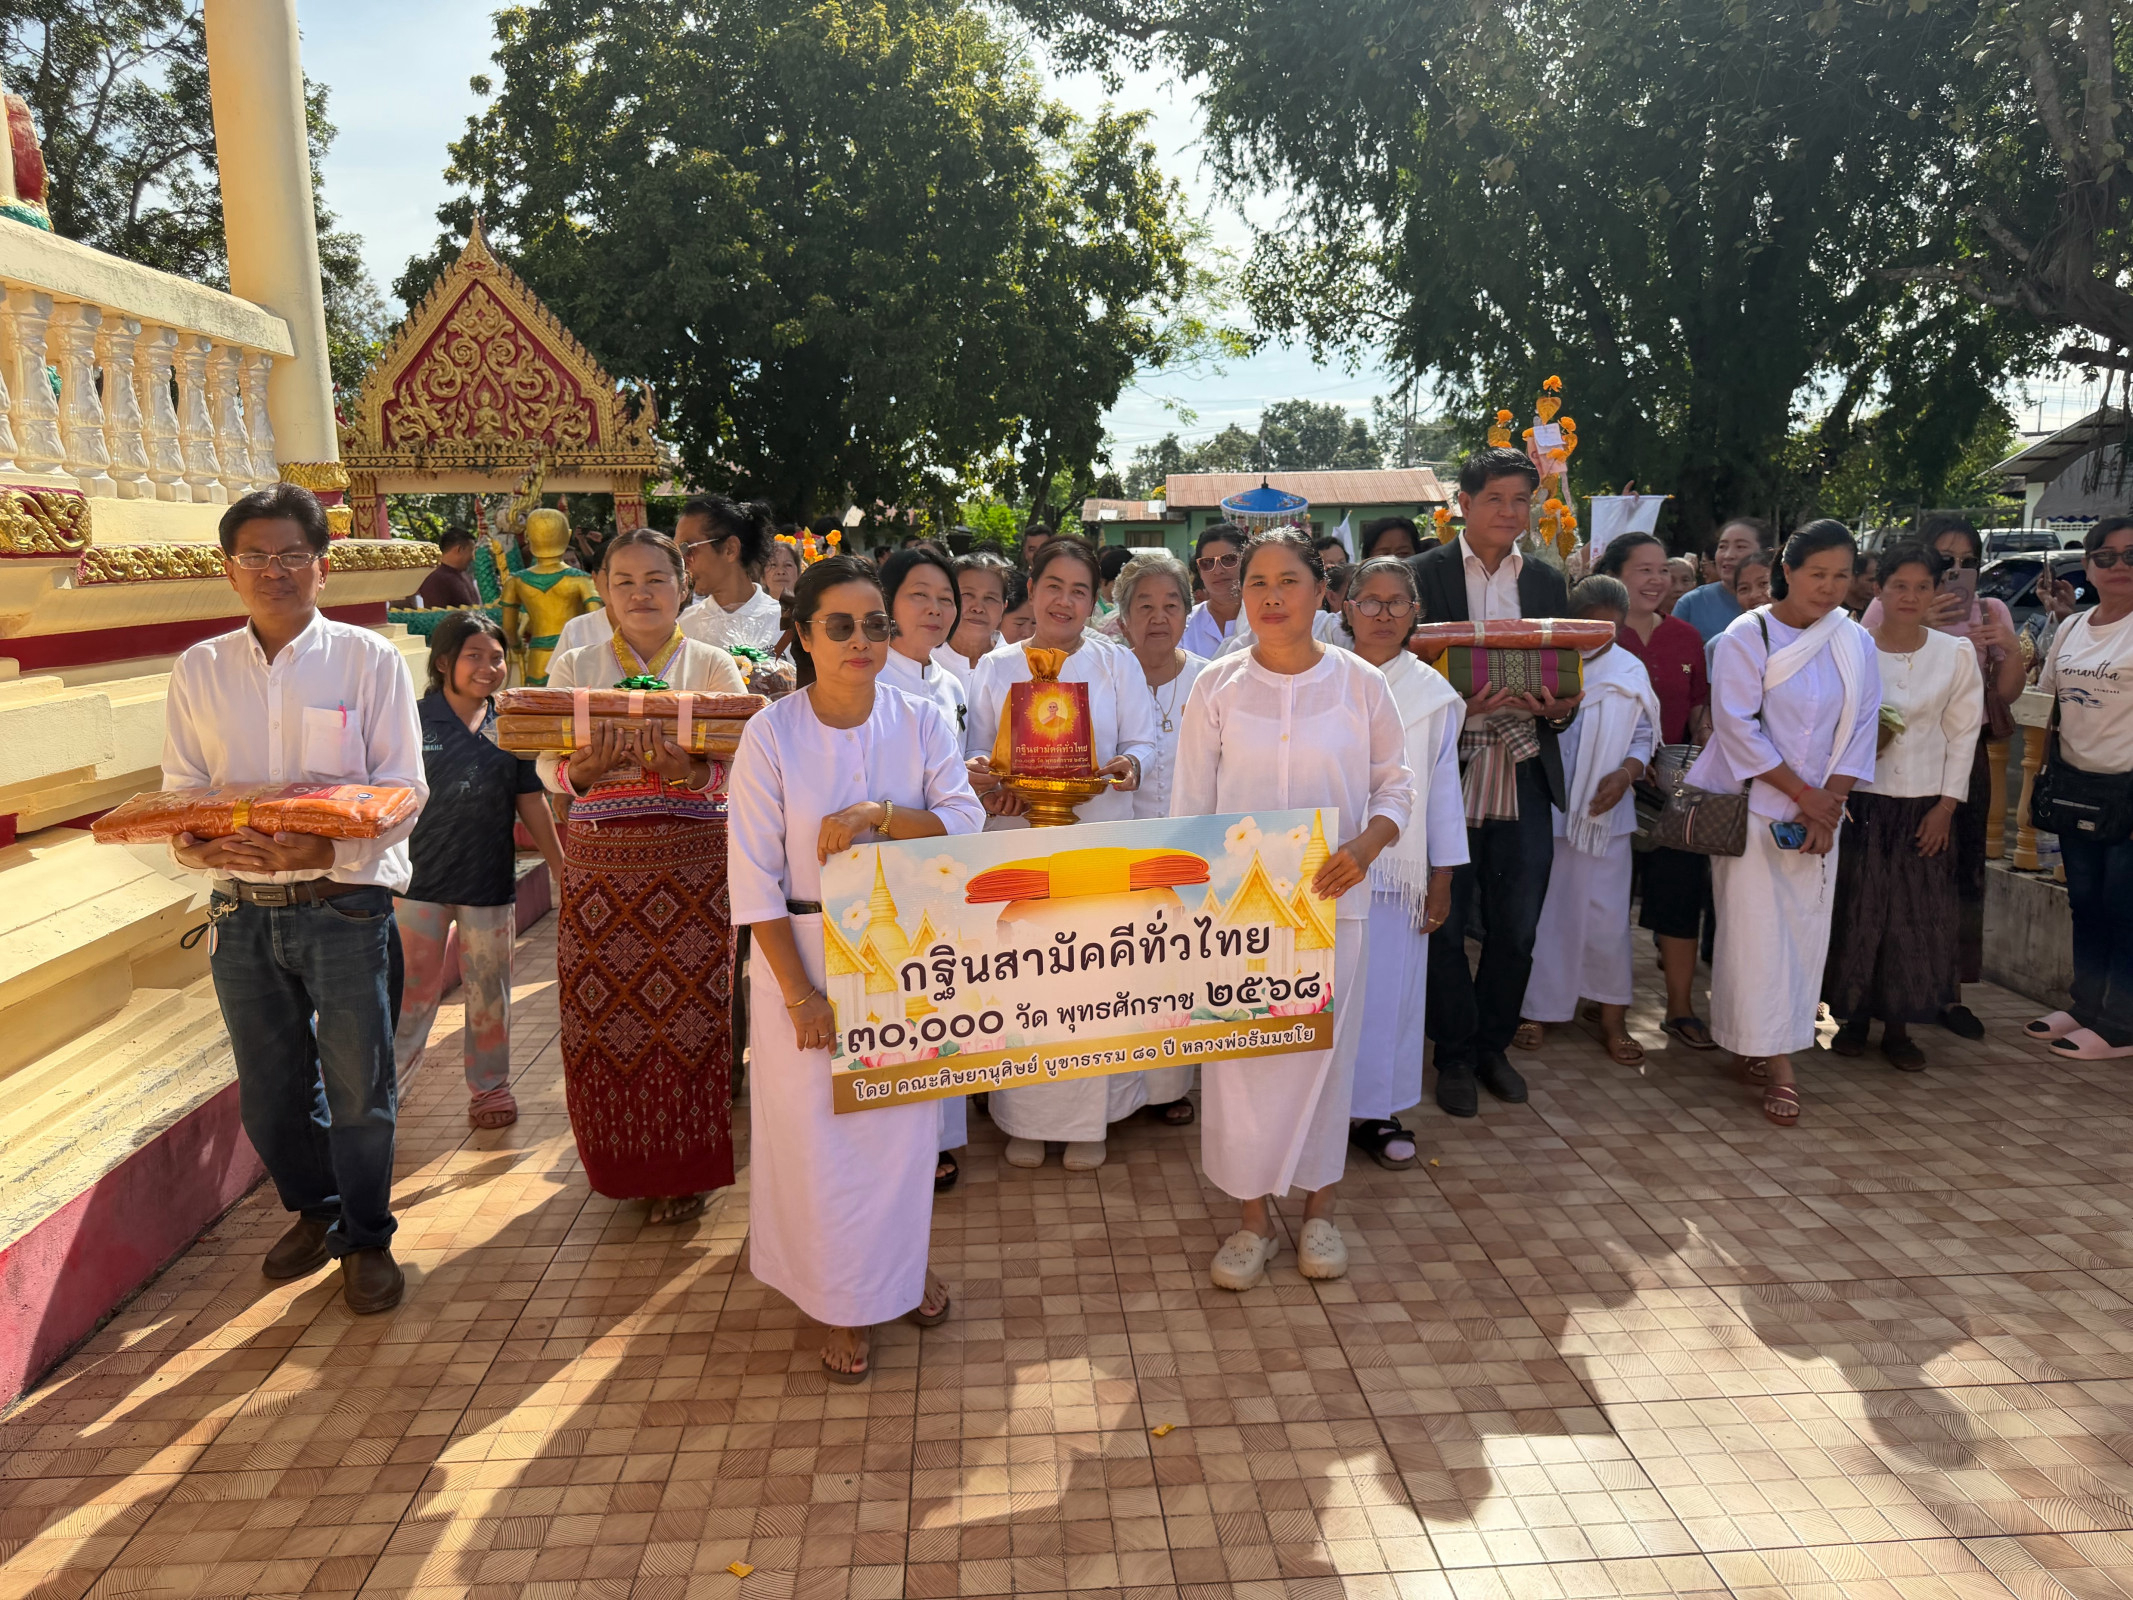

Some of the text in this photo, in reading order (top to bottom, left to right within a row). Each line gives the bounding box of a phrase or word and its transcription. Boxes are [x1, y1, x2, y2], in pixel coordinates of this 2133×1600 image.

[900, 909, 1271, 1001] กฐินสามัคคีทั่วไทย
[847, 971, 1321, 1054] ๓๐,๐๐๐ วัด พุทธศักราช ๒๕๖๘
[854, 1024, 1315, 1101] โดย คณะศิษยานุศิษย์ บูชาธรรม ๘๑ ปี หลวงพ่อธัมมชโย
